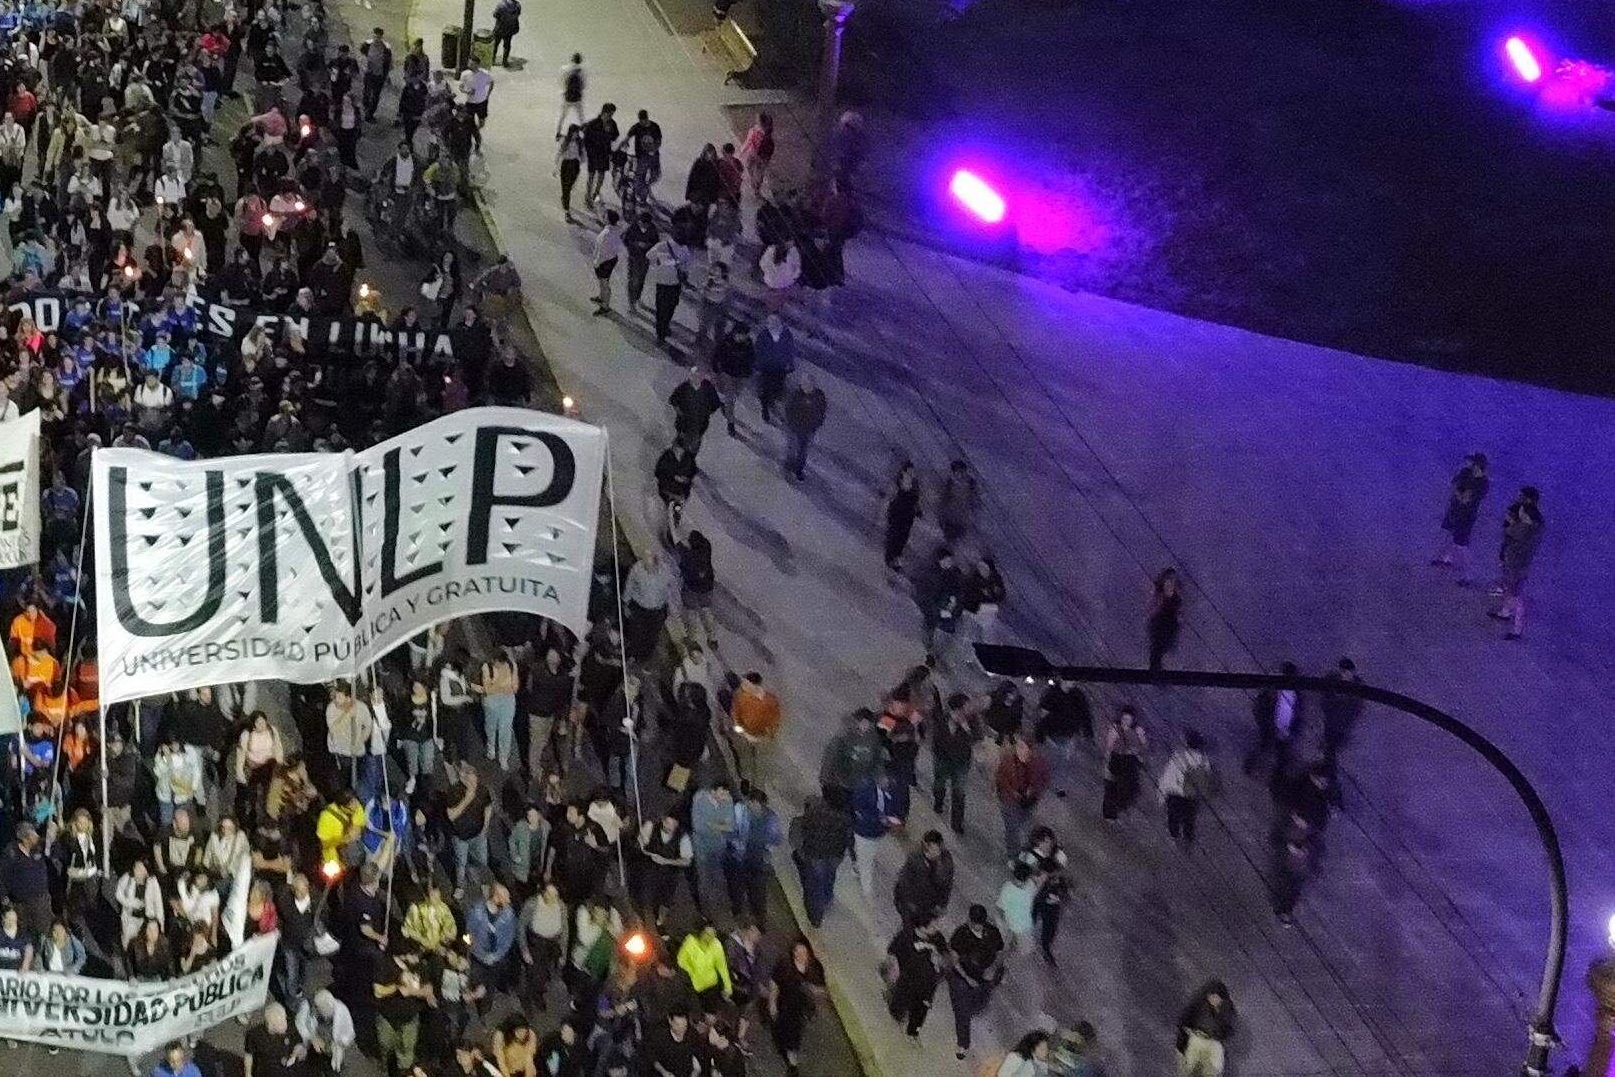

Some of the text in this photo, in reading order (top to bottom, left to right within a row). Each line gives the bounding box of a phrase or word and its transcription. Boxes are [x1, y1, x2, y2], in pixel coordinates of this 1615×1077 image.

[108, 425, 576, 636] UNLP
[122, 637, 305, 677] UNIVERSIDAD
[407, 597, 420, 615] Y
[426, 576, 562, 605] GRATUITA
[48, 982, 90, 1005] POR
